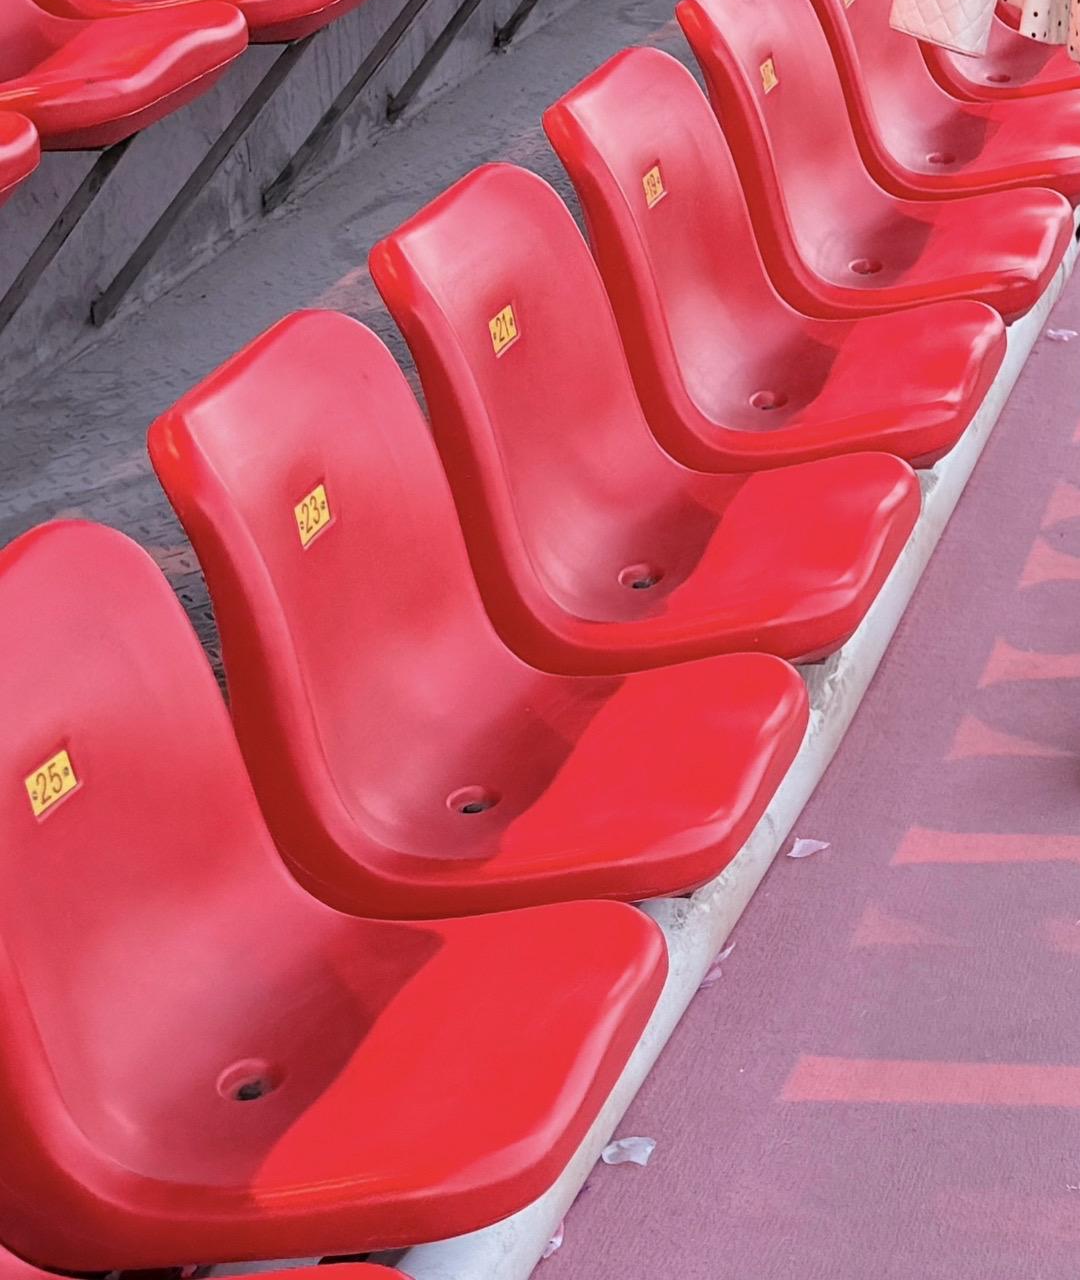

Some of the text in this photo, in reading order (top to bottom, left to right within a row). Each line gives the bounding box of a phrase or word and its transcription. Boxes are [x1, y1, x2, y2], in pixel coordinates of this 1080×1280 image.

[495, 313, 511, 343] 21
[301, 495, 321, 534] 23
[35, 762, 63, 805] 25
